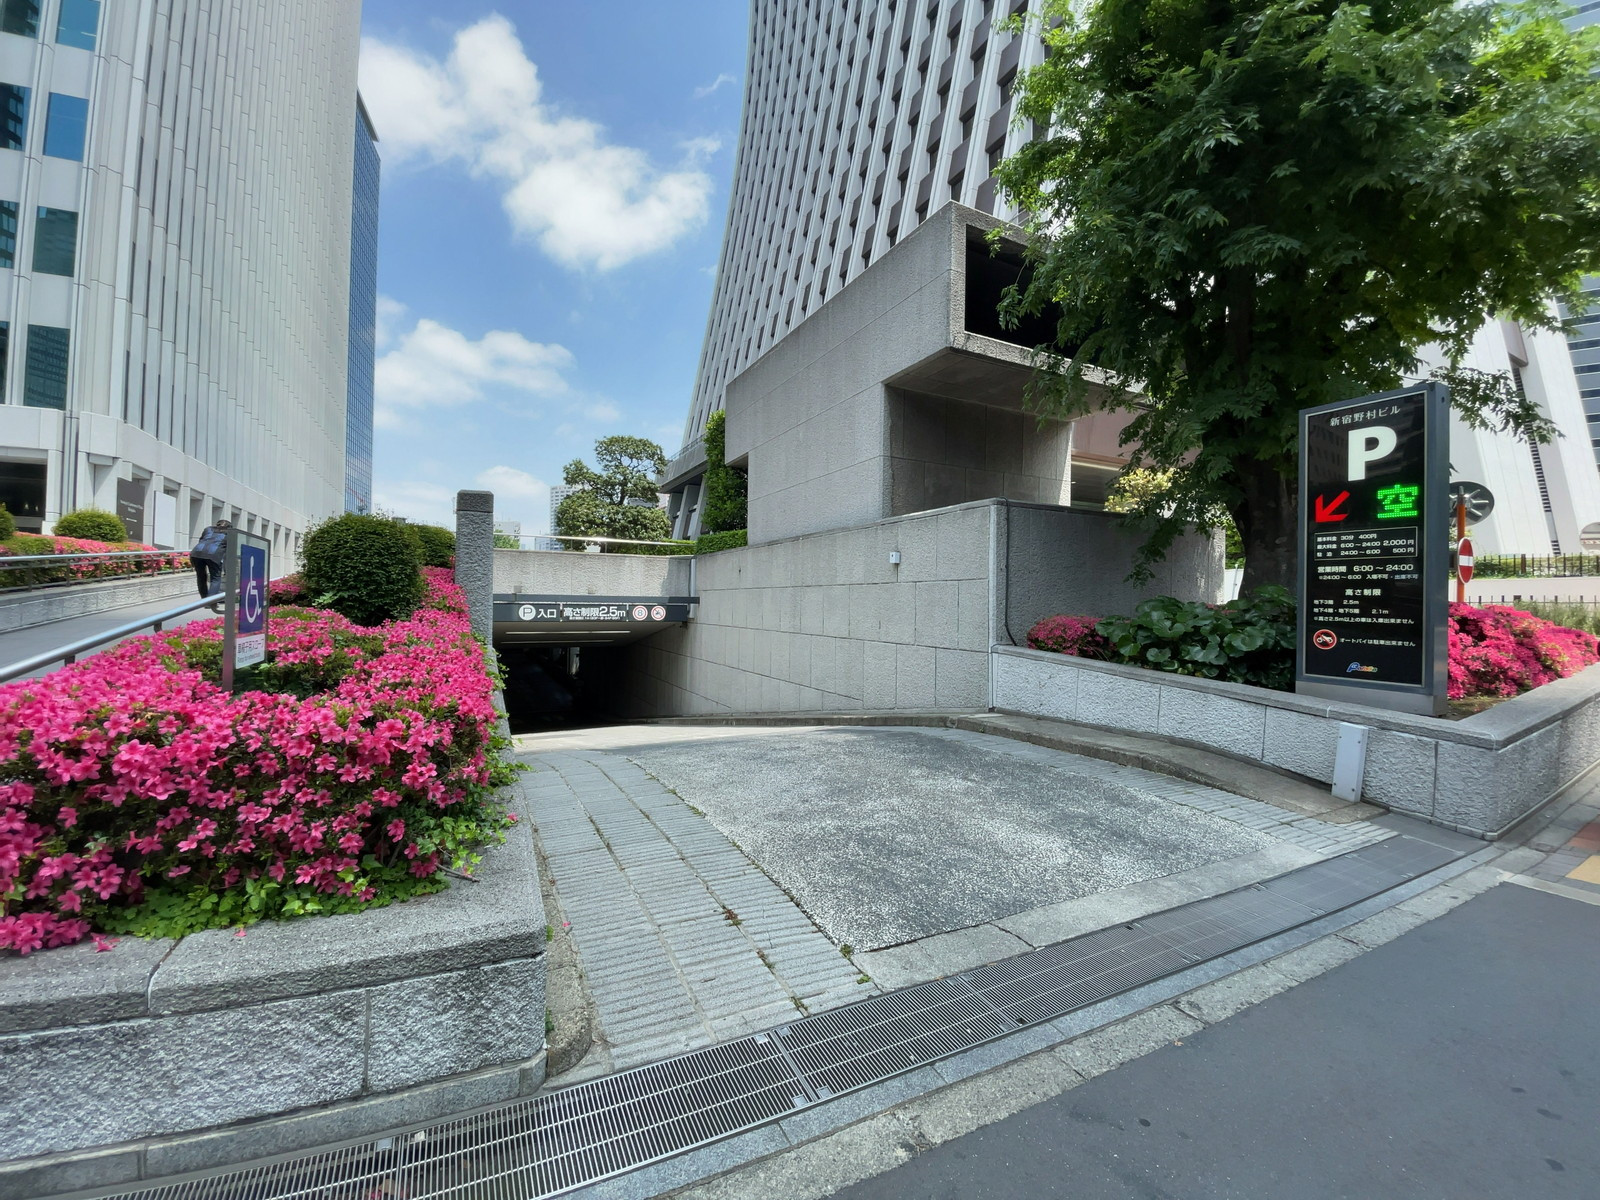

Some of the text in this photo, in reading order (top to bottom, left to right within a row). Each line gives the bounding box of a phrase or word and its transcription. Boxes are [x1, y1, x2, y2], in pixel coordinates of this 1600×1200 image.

[1329, 405, 1401, 426] 新宿野村ビル
[1348, 426, 1397, 481] P
[1377, 484, 1418, 519] 空
[1317, 565, 1347, 574] 営業時間
[1345, 588, 1382, 597] 高さ制限
[537, 609, 557, 619] 入口
